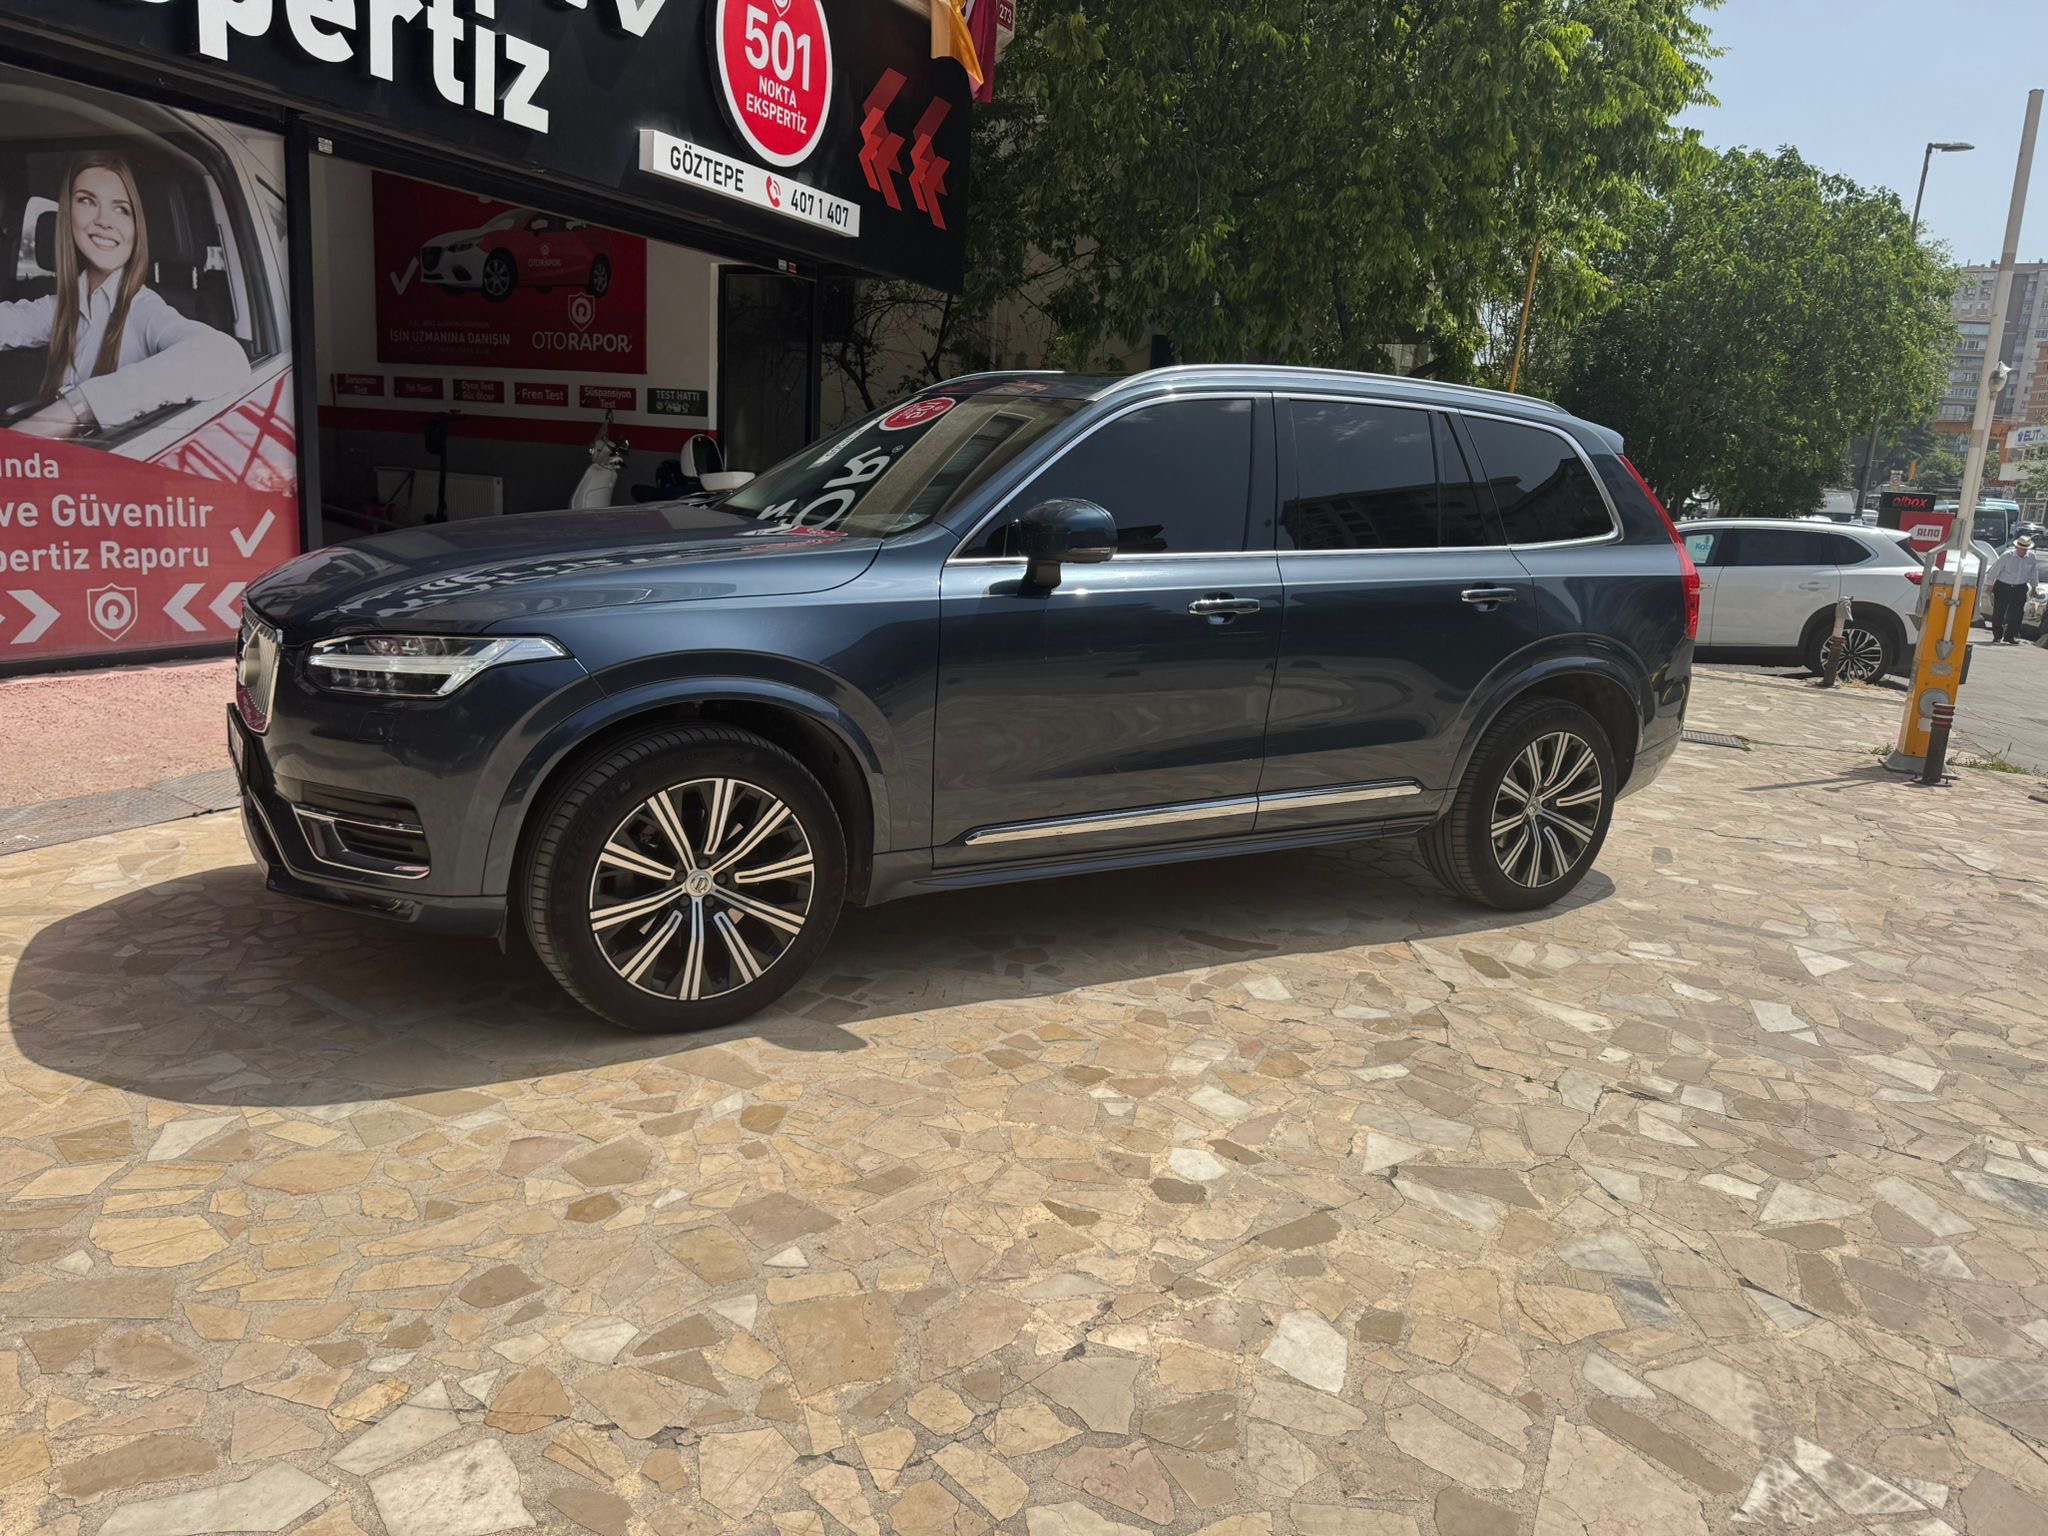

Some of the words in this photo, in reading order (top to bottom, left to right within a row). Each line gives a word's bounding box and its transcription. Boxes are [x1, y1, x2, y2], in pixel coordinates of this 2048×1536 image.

[745, 3, 810, 91] 501
[759, 75, 797, 108] NOKTA
[746, 92, 807, 134] EKSPERTİZ
[670, 144, 744, 192] GÖZTEPE
[790, 189, 814, 215] 407
[827, 204, 849, 227] 407
[532, 331, 632, 353] OTORAPOR
[522, 388, 543, 400] Fren
[545, 389, 564, 401] Test
[656, 390, 674, 400] TEST
[51, 493, 213, 528] Güvenilir
[100, 541, 209, 575] Raporu
